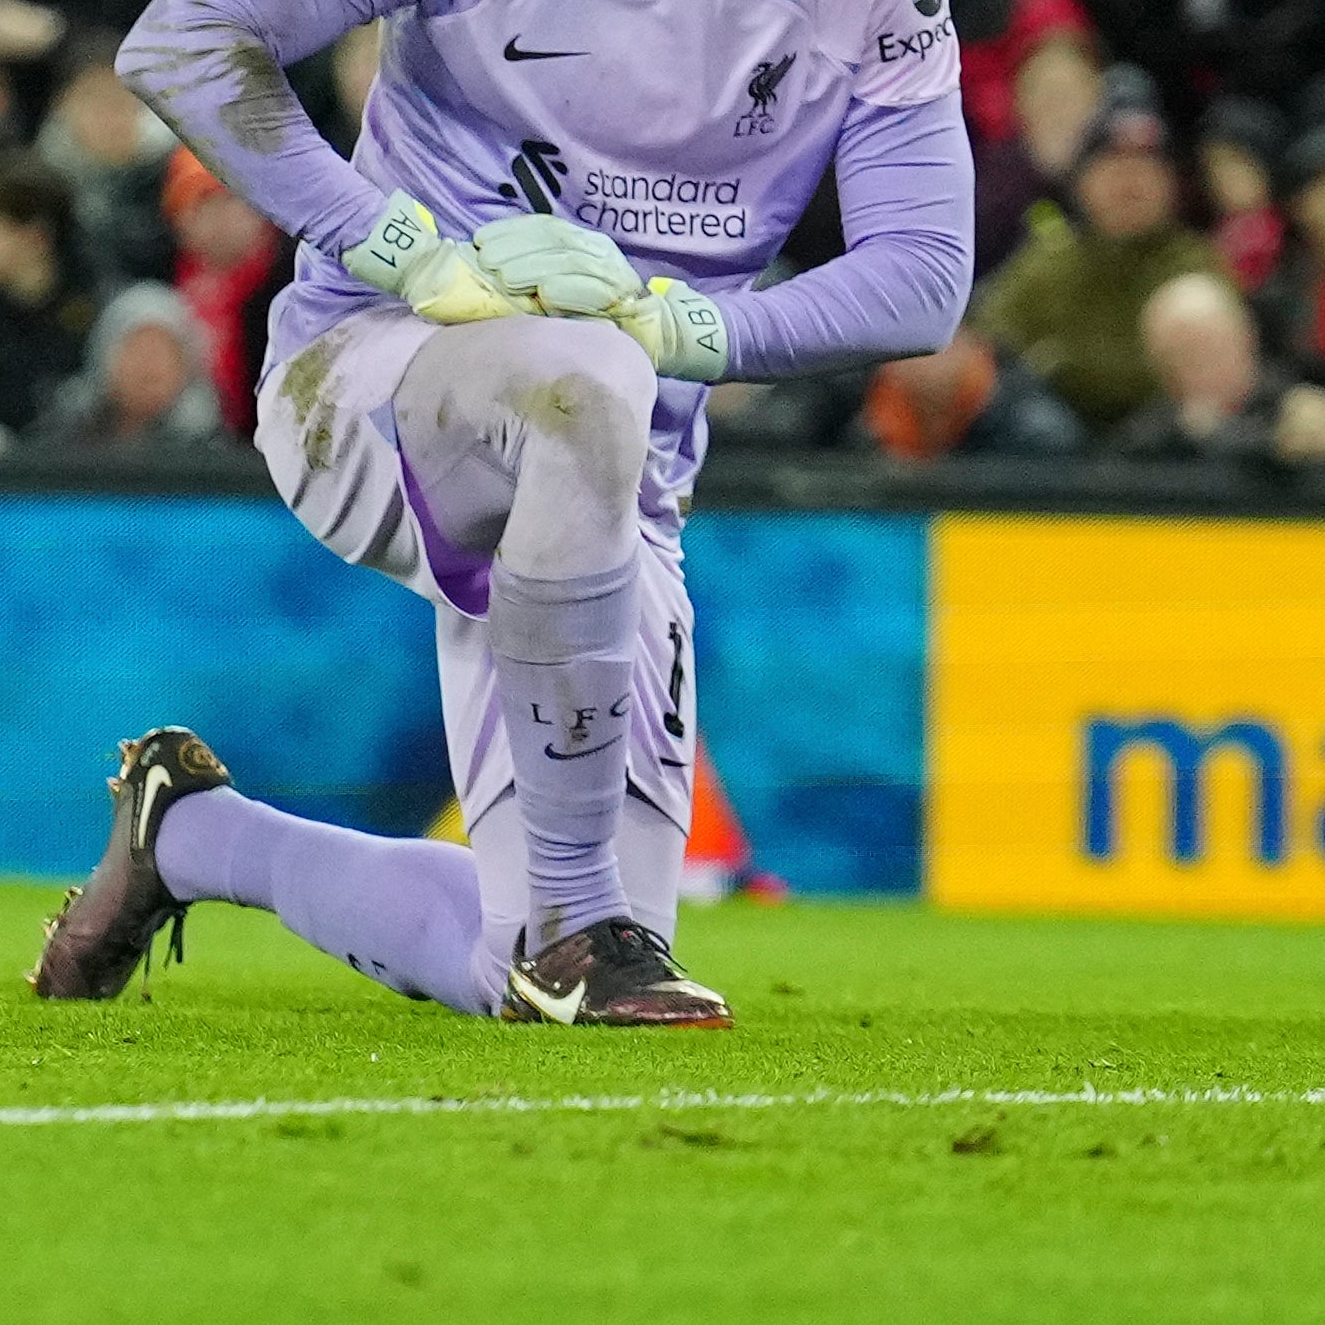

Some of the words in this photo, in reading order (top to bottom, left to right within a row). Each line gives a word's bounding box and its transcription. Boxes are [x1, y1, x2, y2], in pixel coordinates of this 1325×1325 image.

[584, 169, 741, 205] standard
[369, 209, 422, 269] AB1
[576, 199, 747, 239] chartered
[679, 298, 720, 354] AB1
[1082, 716, 1325, 867] m
